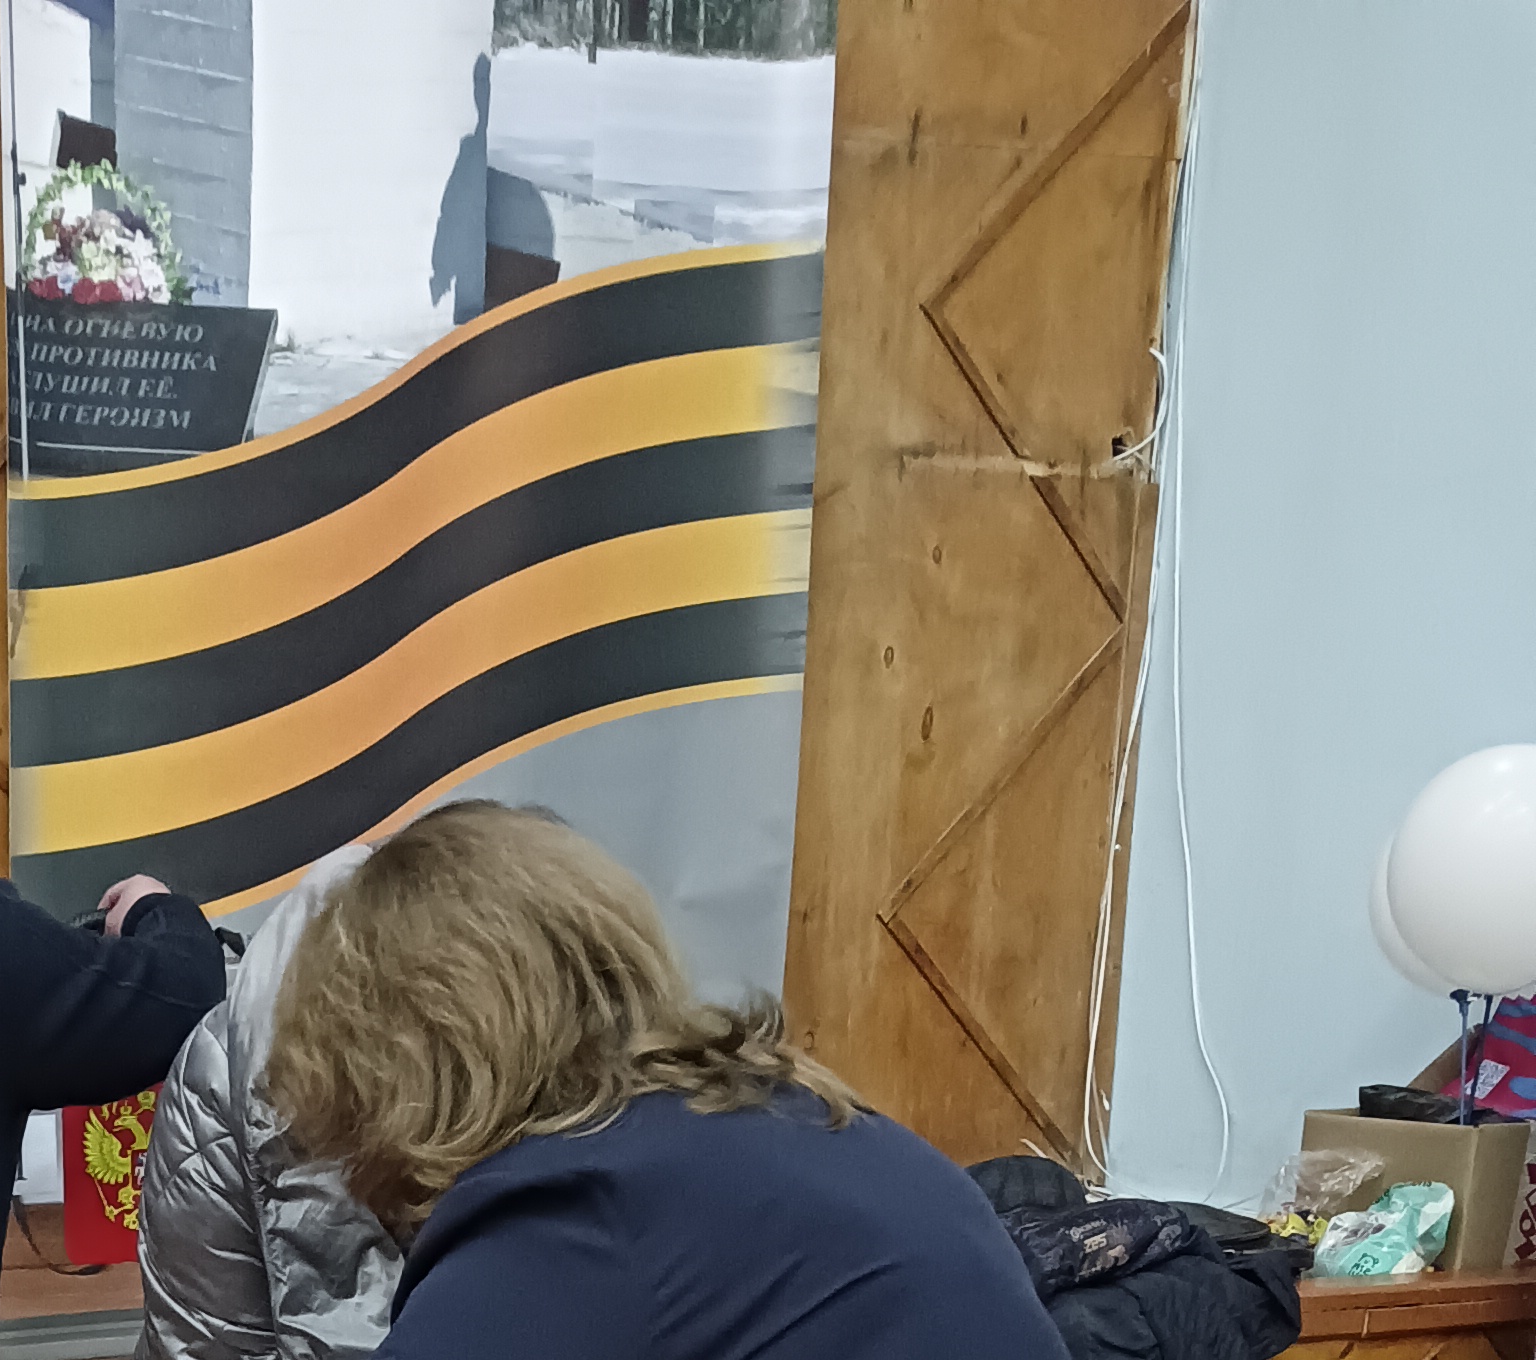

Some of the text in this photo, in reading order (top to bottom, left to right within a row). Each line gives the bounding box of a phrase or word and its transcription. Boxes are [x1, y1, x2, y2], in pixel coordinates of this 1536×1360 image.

[26, 314, 57, 333] НА
[64, 318, 204, 343] ОГНЕВУЮ
[30, 341, 218, 372] ПРОТИВНИКА
[25, 370, 132, 397] ЛУШИЛ
[58, 402, 192, 430] ГЕРОИЗМ
